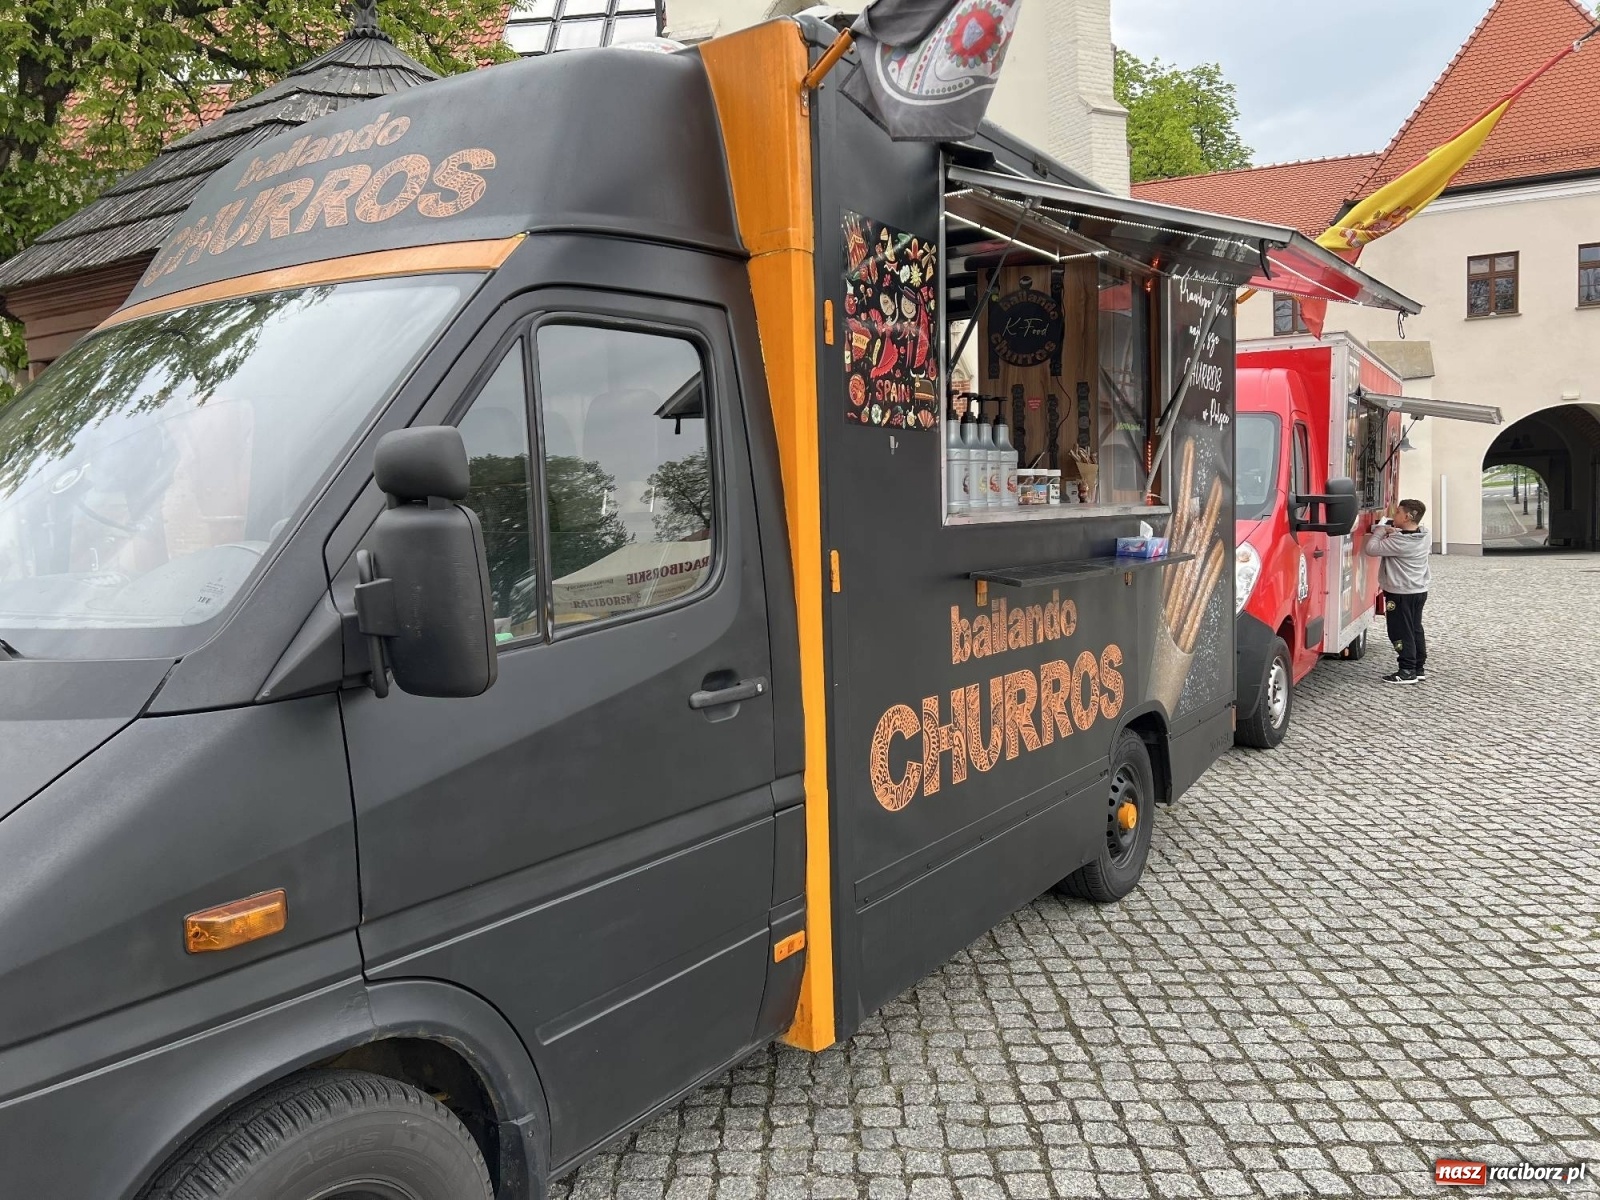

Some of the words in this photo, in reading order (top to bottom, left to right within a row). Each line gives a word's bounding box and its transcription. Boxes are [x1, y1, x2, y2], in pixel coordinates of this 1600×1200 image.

[233, 112, 411, 192] bailando
[143, 147, 497, 289] CHURROS
[875, 379, 911, 404] SPAIN
[950, 588, 1078, 665] bailando
[869, 644, 1125, 812] CHURROS
